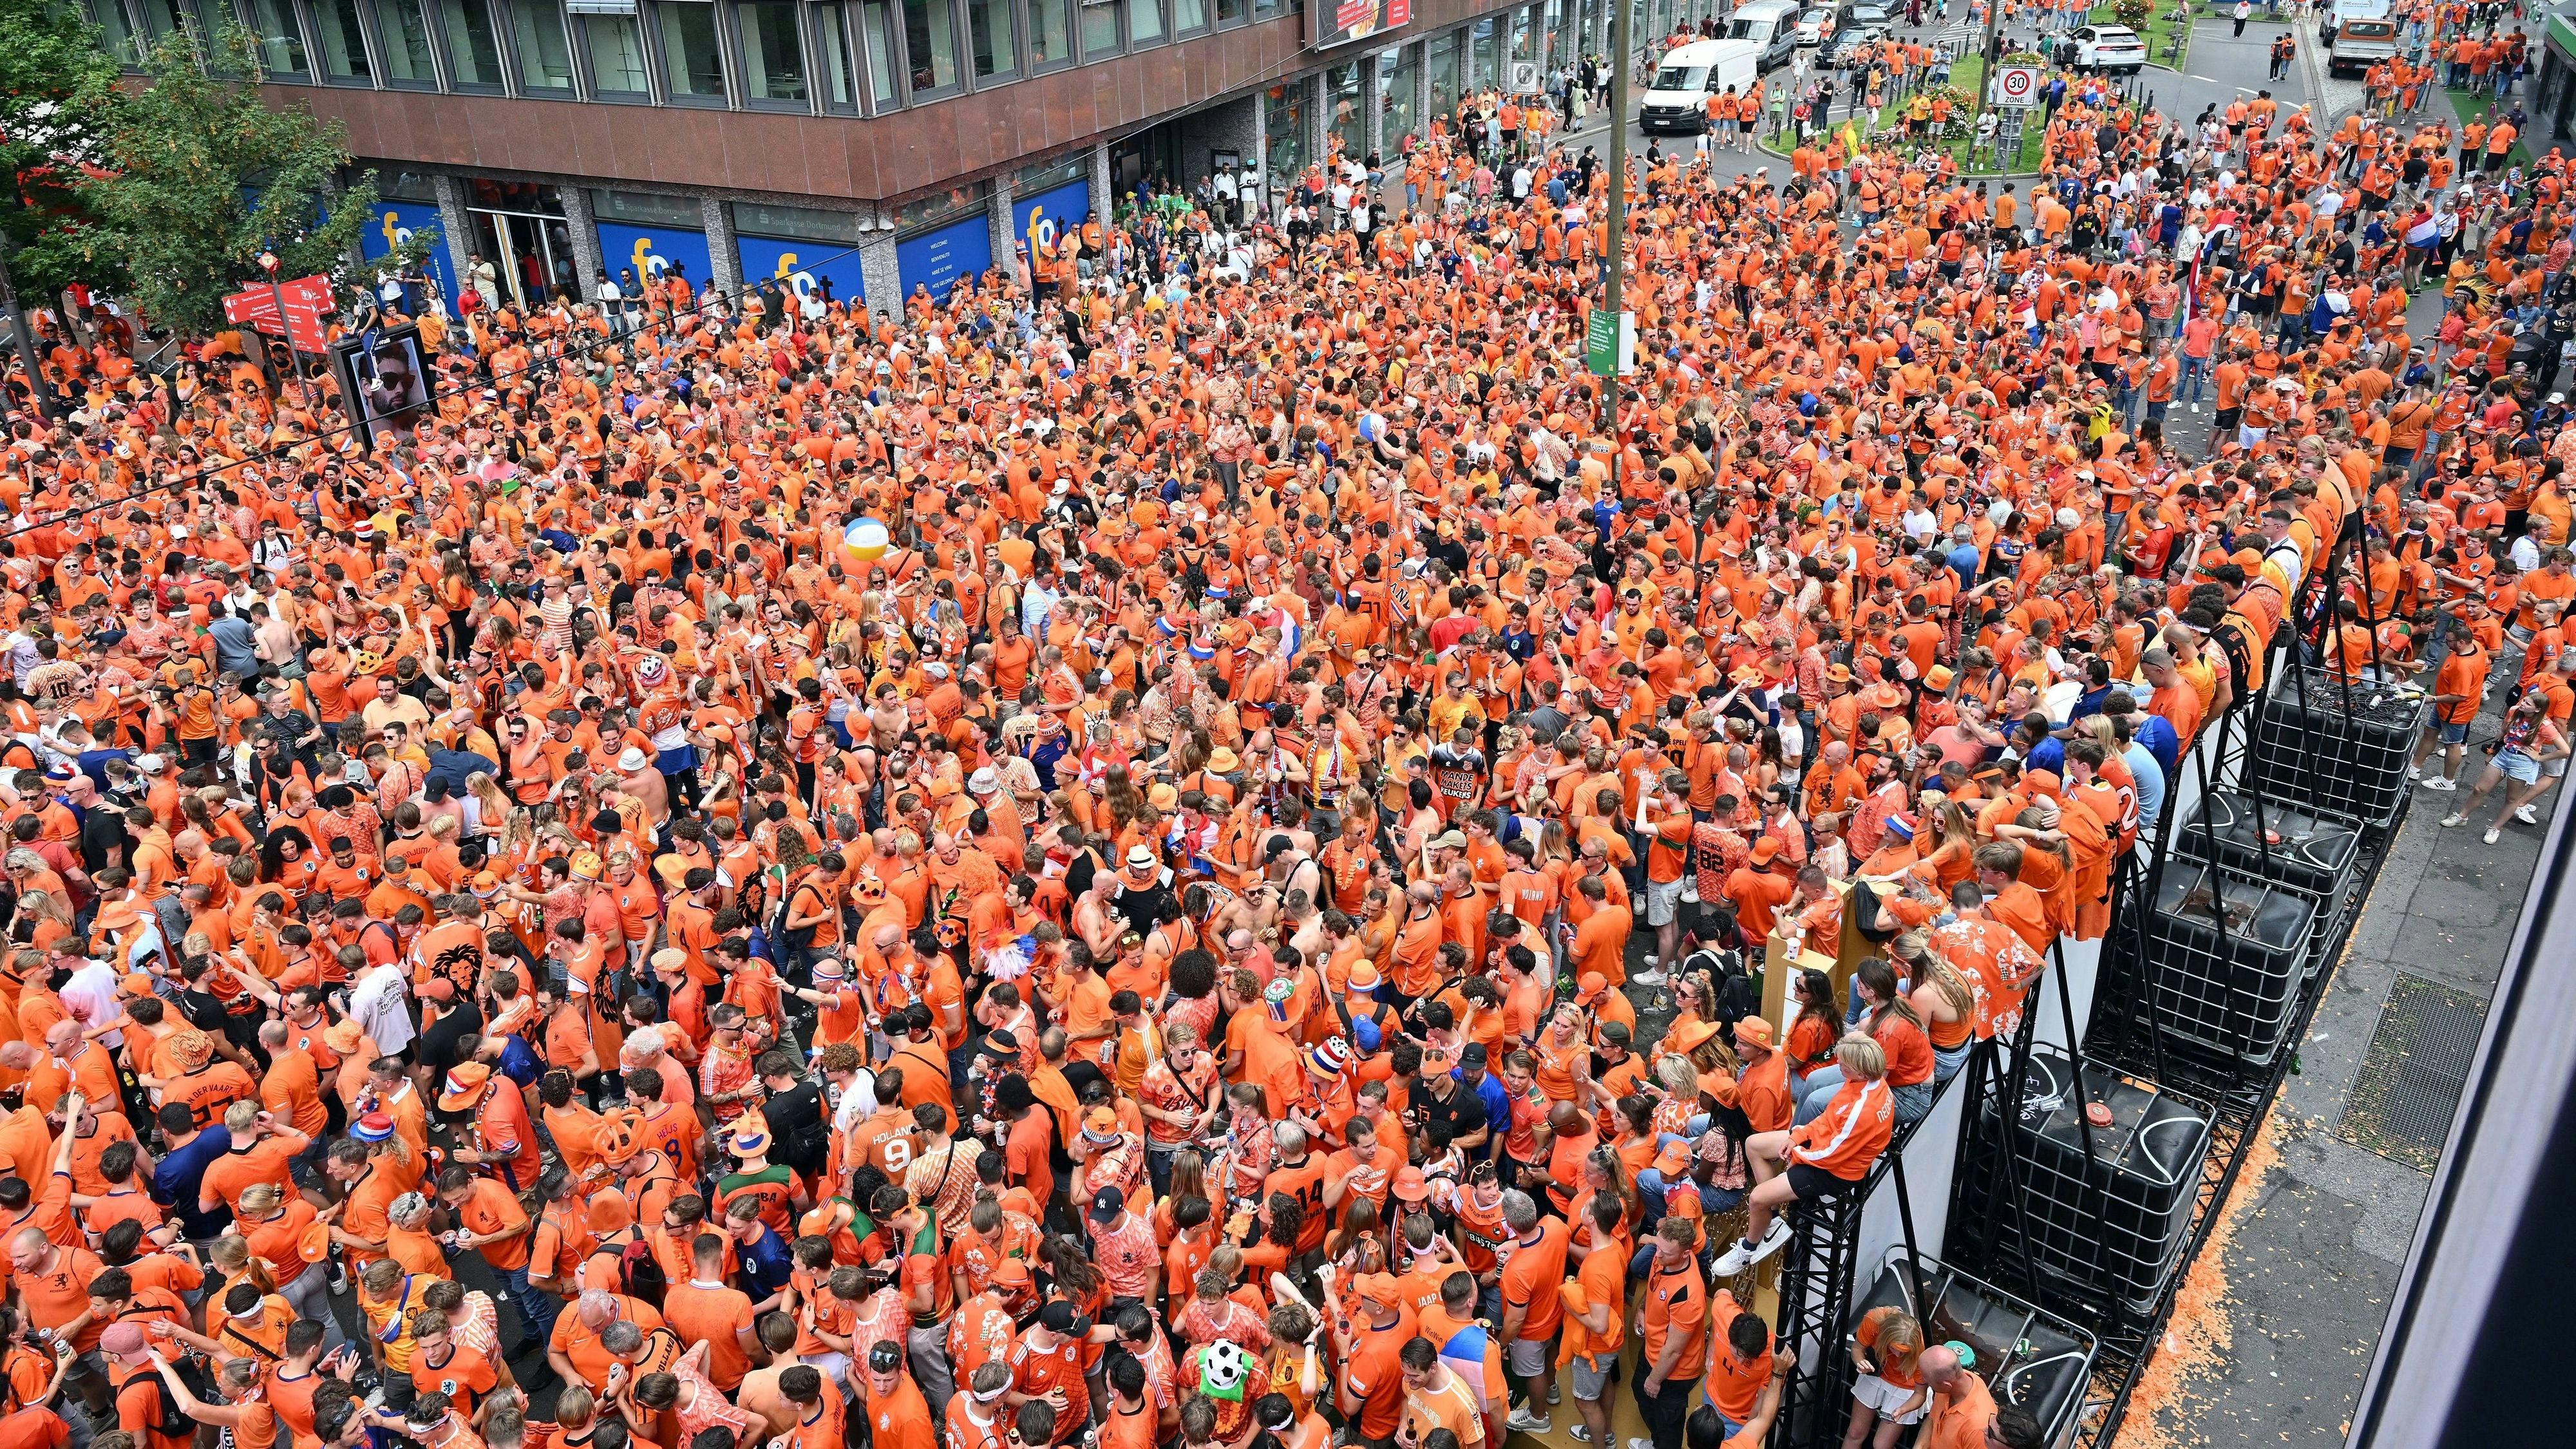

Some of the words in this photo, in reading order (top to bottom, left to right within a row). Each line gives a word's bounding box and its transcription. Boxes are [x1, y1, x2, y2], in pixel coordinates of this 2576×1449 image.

[1337, 5, 1352, 15] Cashback
[2009, 77, 2024, 89] 30
[626, 205, 658, 214] Sparkasse
[659, 207, 690, 217] Dortmund
[771, 216, 804, 228] Sparkasse
[806, 220, 841, 232] Dortmund
[930, 239, 948, 250] WELCOME!
[1763, 325, 1776, 341] 12
[1370, 590, 1383, 599] JONG
[21, 650, 40, 661] ING
[47, 674, 68, 683] GULLIT
[51, 681, 70, 700] 10
[1041, 721, 1065, 736] HOLLAND
[1441, 770, 1474, 782] MANDE
[1441, 787, 1472, 800] KEUKENS
[1700, 840, 1723, 854] SEINEN
[1700, 849, 1724, 875] 82
[519, 902, 535, 936] 22
[389, 990, 402, 1004] new
[194, 1088, 208, 1100] DER
[209, 1084, 233, 1094] VAART
[657, 1123, 679, 1141] HEIJS
[873, 1126, 916, 1146] HOLLAND
[1086, 1129, 1117, 1142] HOLLAND
[663, 1137, 684, 1169] 8
[884, 1139, 912, 1173] 9
[1295, 1182, 1324, 1211] 14
[1418, 1293, 1437, 1308] JAAP
[1425, 1325, 1443, 1344] WinWin
[1723, 1356, 1734, 1377] 4
[1408, 1393, 1441, 1428] HOLLAND
